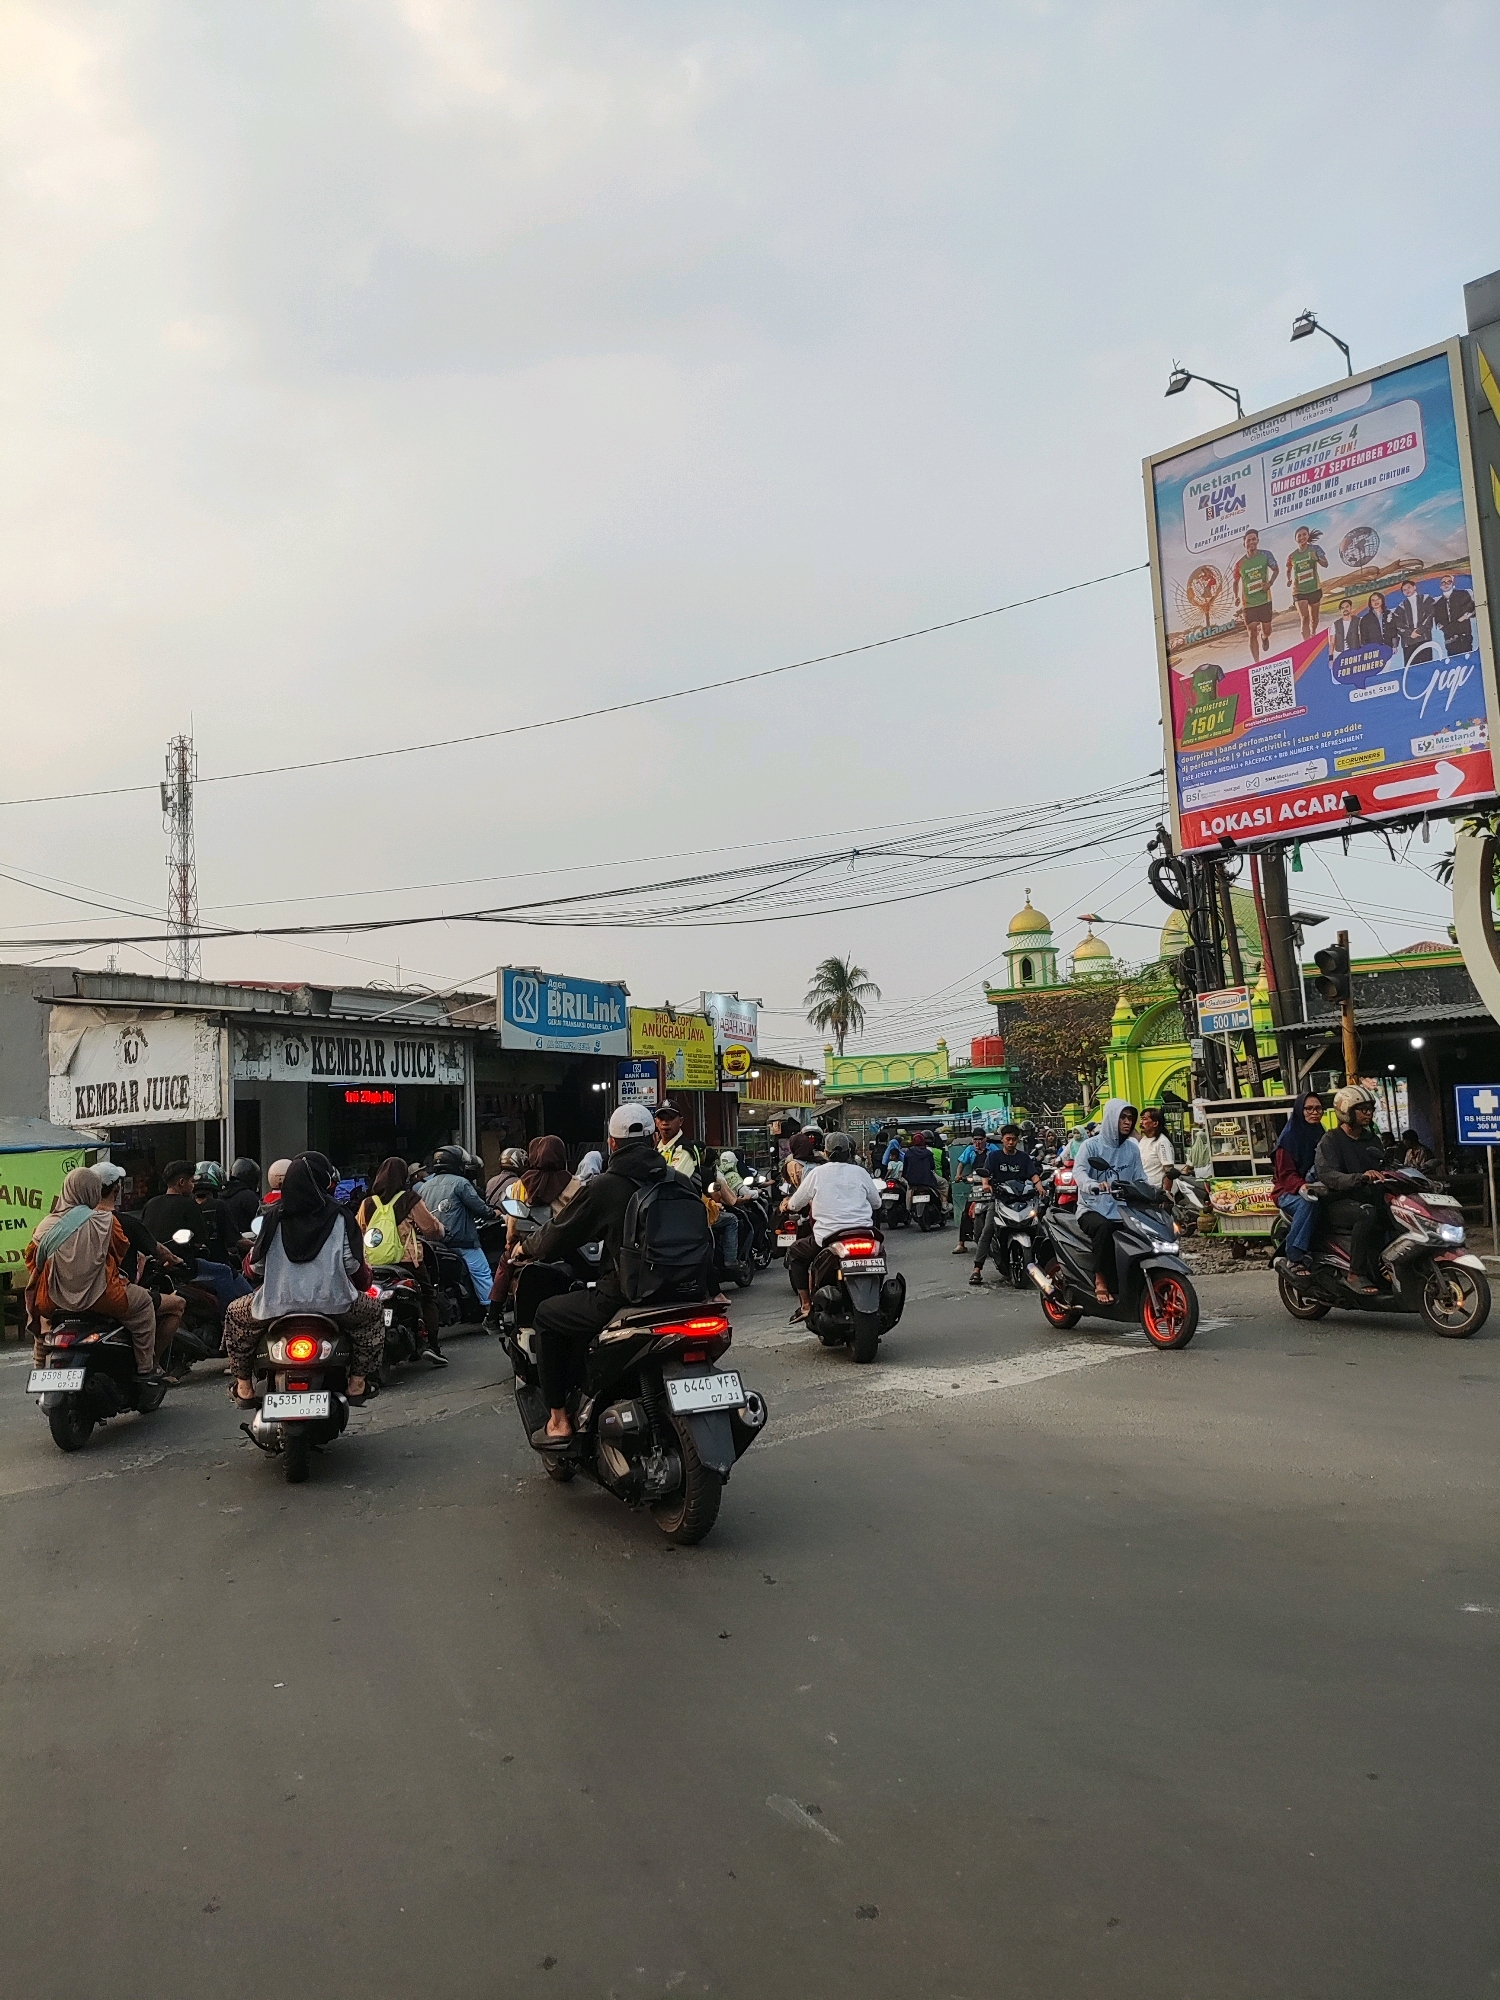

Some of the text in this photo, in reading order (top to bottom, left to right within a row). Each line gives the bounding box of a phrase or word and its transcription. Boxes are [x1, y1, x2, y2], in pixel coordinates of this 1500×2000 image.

[1295, 394, 1338, 416] Metland
[1302, 405, 1333, 424] cikarang
[1243, 414, 1287, 437] Metland
[1250, 426, 1279, 442] cibitung
[1271, 423, 1359, 468] SERIES 4
[1272, 440, 1358, 482] 5K NONSTOP FUN!
[1272, 436, 1413, 496] MINGGU, 27 SEPTEMBER 2026
[1189, 464, 1252, 497] Metland
[1198, 484, 1237, 510] RUN
[1273, 477, 1339, 507] START 06:00 WIB
[1274, 466, 1411, 517] METLAND CIKARANG & METLAND CIBITUNG
[1210, 524, 1230, 537] LARI,
[1194, 539, 1211, 549] DAPAT
[1185, 620, 1236, 645] Metland
[1337, 660, 1384, 678] FOR RUNNERS
[1340, 650, 1380, 667] FRONT ROW
[1252, 664, 1274, 675] DAFTAR
[1353, 684, 1396, 699] Guest Star
[1194, 698, 1229, 714] Registrasi
[1191, 710, 1225, 736] 150 K
[1181, 750, 1213, 763] doorprize
[1219, 742, 1237, 754] band
[1238, 733, 1282, 749] perfomance
[1190, 756, 1230, 772] perfomance
[1236, 752, 1241, 760] 9
[1242, 747, 1254, 759] fun
[1256, 740, 1292, 754] activities
[1298, 733, 1319, 747] stand
[1321, 731, 1332, 743] up
[1334, 723, 1362, 738] paddle
[1290, 745, 1314, 758] NUMBER
[1320, 735, 1364, 751] REFRESHMENT
[1435, 731, 1476, 745] Metland
[1264, 774, 1276, 783] SMK
[1186, 790, 1200, 803] BSI
[1201, 806, 1272, 837] LOKASI
[547, 979, 567, 991] Agen
[547, 989, 621, 1024] BRILink
[677, 1016, 693, 1028] COPY
[1213, 1011, 1240, 1030] 500 M
[642, 1023, 686, 1040] ANUGRAH
[687, 1028, 706, 1042] JAYA
[125, 1040, 138, 1065] KJ
[285, 1042, 300, 1067] KJ
[311, 1036, 437, 1078] KEMBAR JUICE
[75, 1074, 191, 1119] KEMBAR JUICE
[1237, 1186, 1263, 1199] BAKSO
[32, 1372, 37, 1381] B
[41, 1371, 62, 1381] 5598
[670, 1383, 678, 1396] B
[716, 1375, 738, 1389] YFB
[267, 1394, 328, 1406] B 5351 FRV
